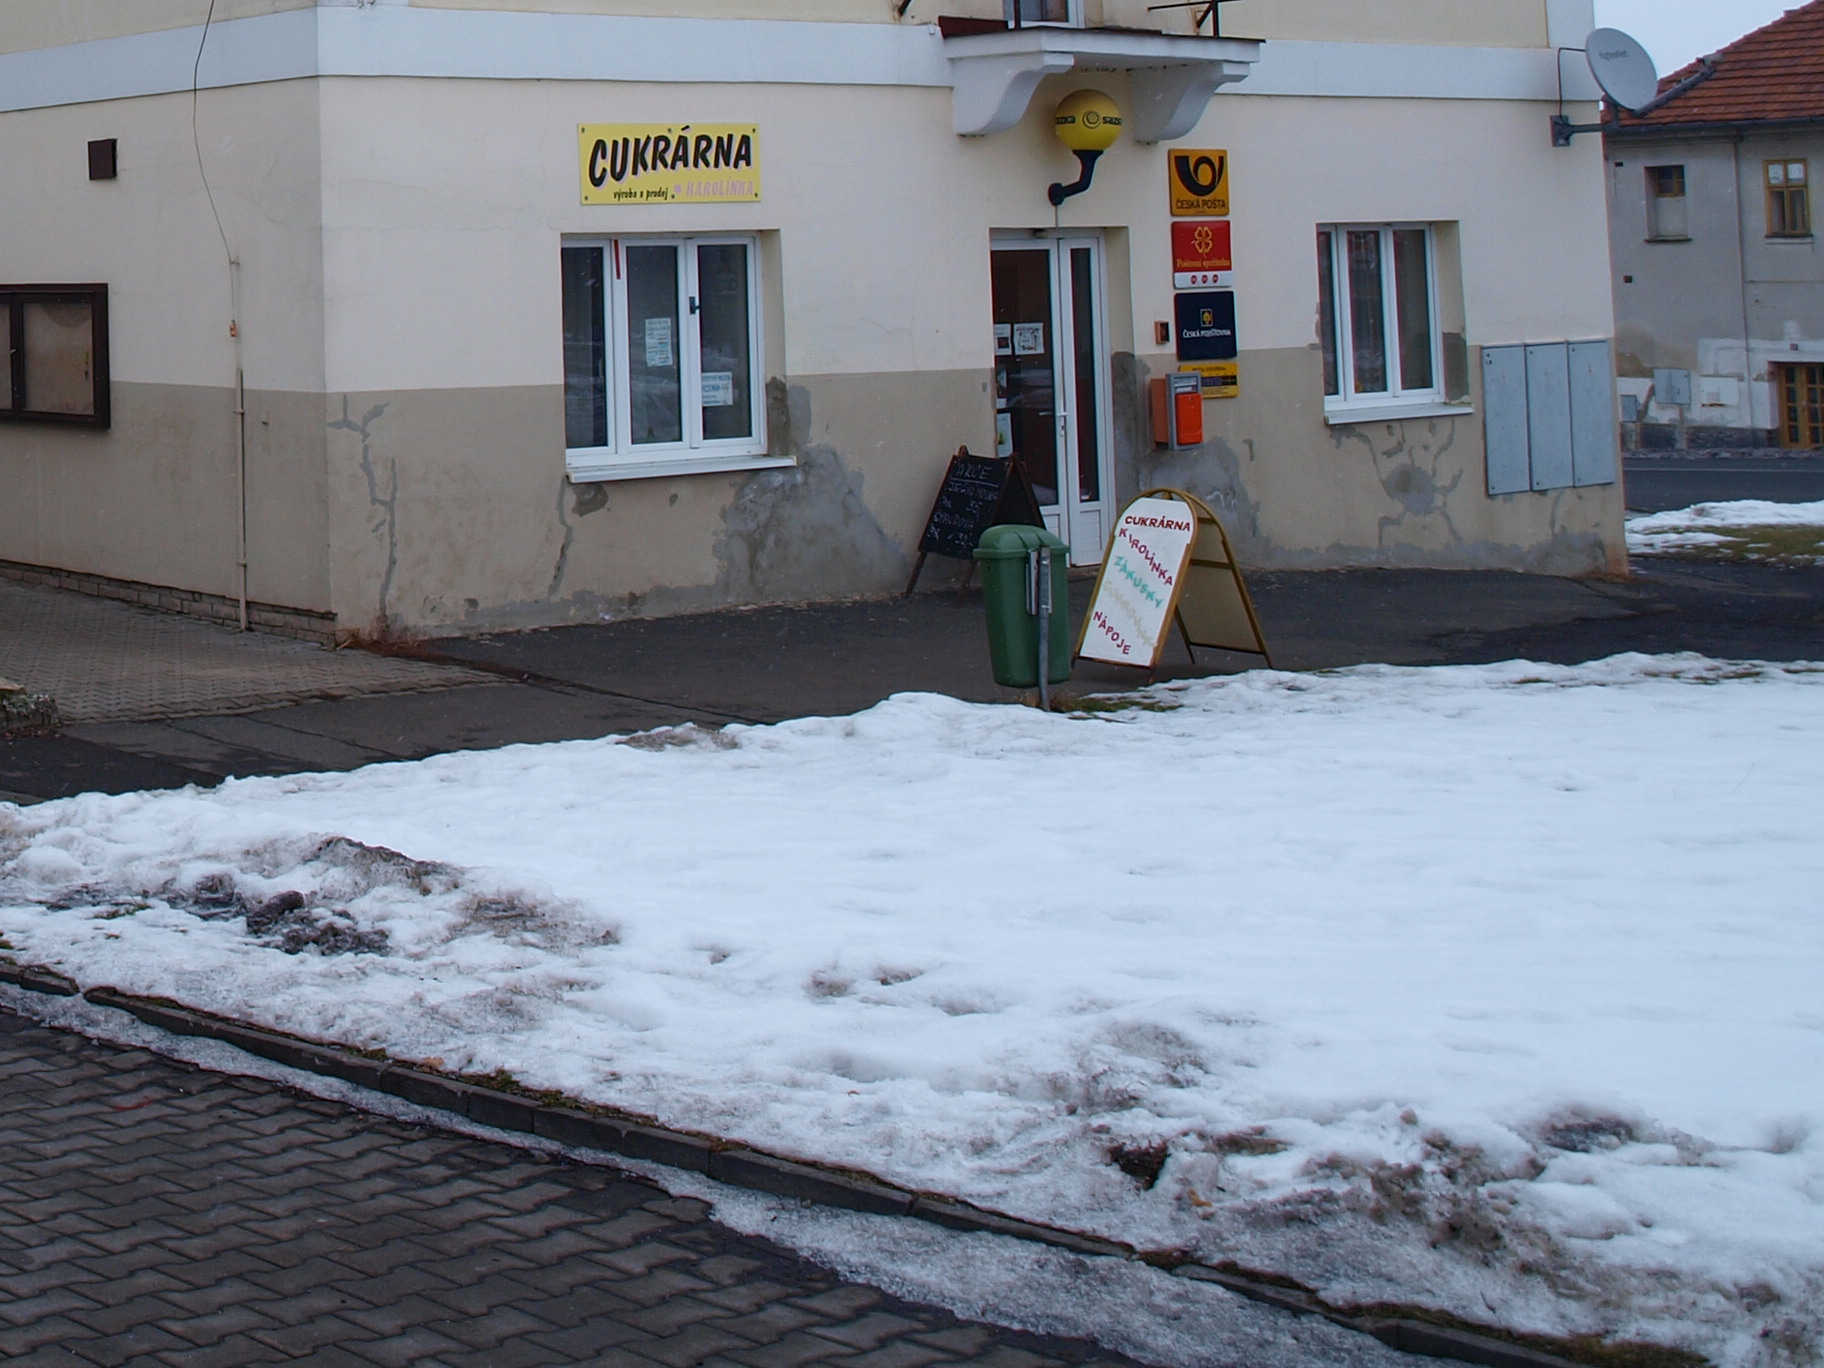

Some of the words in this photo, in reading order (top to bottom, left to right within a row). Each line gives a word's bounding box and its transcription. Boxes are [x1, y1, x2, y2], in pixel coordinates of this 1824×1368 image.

[589, 125, 752, 187] CUKRÁRNA
[645, 187, 669, 201] prodej
[1176, 198, 1201, 209] ČESKÁ
[1201, 198, 1226, 209] POŠTA
[1125, 516, 1191, 532] CUKRÁRNA
[1114, 556, 1164, 608] ZÁKUSKY
[1093, 611, 1131, 655] NÁPOJE
